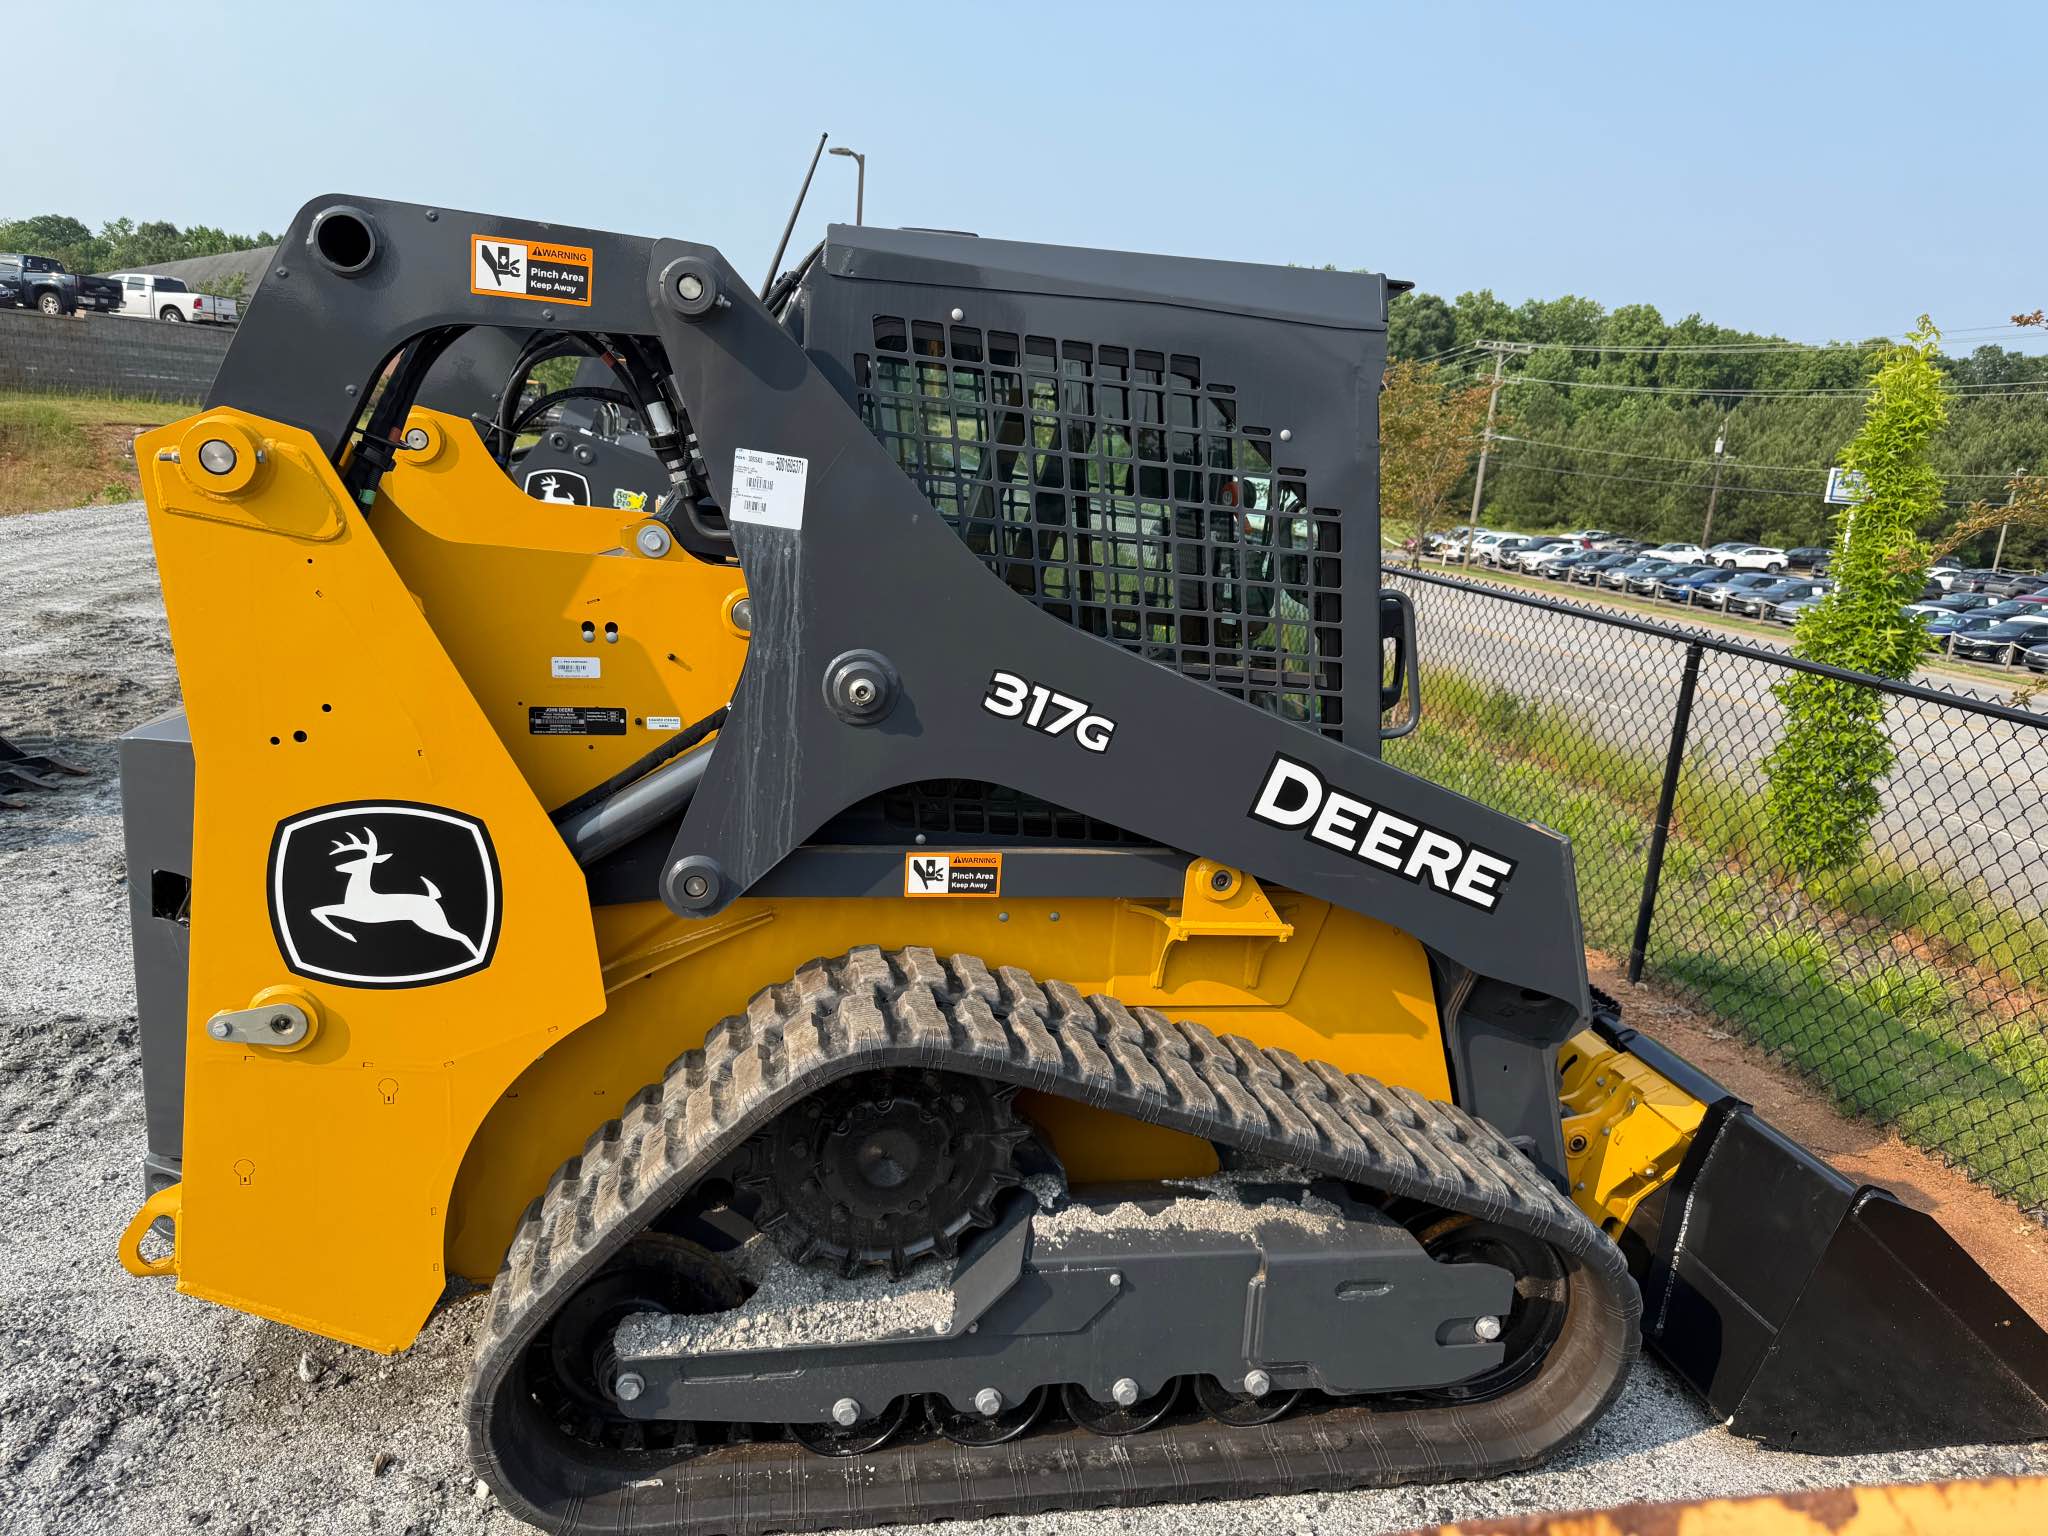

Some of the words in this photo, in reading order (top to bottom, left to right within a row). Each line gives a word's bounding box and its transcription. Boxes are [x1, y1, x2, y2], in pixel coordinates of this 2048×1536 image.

[542, 249, 587, 261] WARNING
[531, 267, 559, 279] Pinch
[561, 270, 584, 283] Area
[530, 280, 552, 292] Keep
[553, 283, 577, 294] Away
[983, 671, 1116, 753] 317G
[1253, 757, 1512, 909] DEERE
[952, 872, 975, 880] Pinch
[976, 872, 994, 880] Area
[951, 881, 968, 889] Keep
[969, 881, 988, 890] Away
